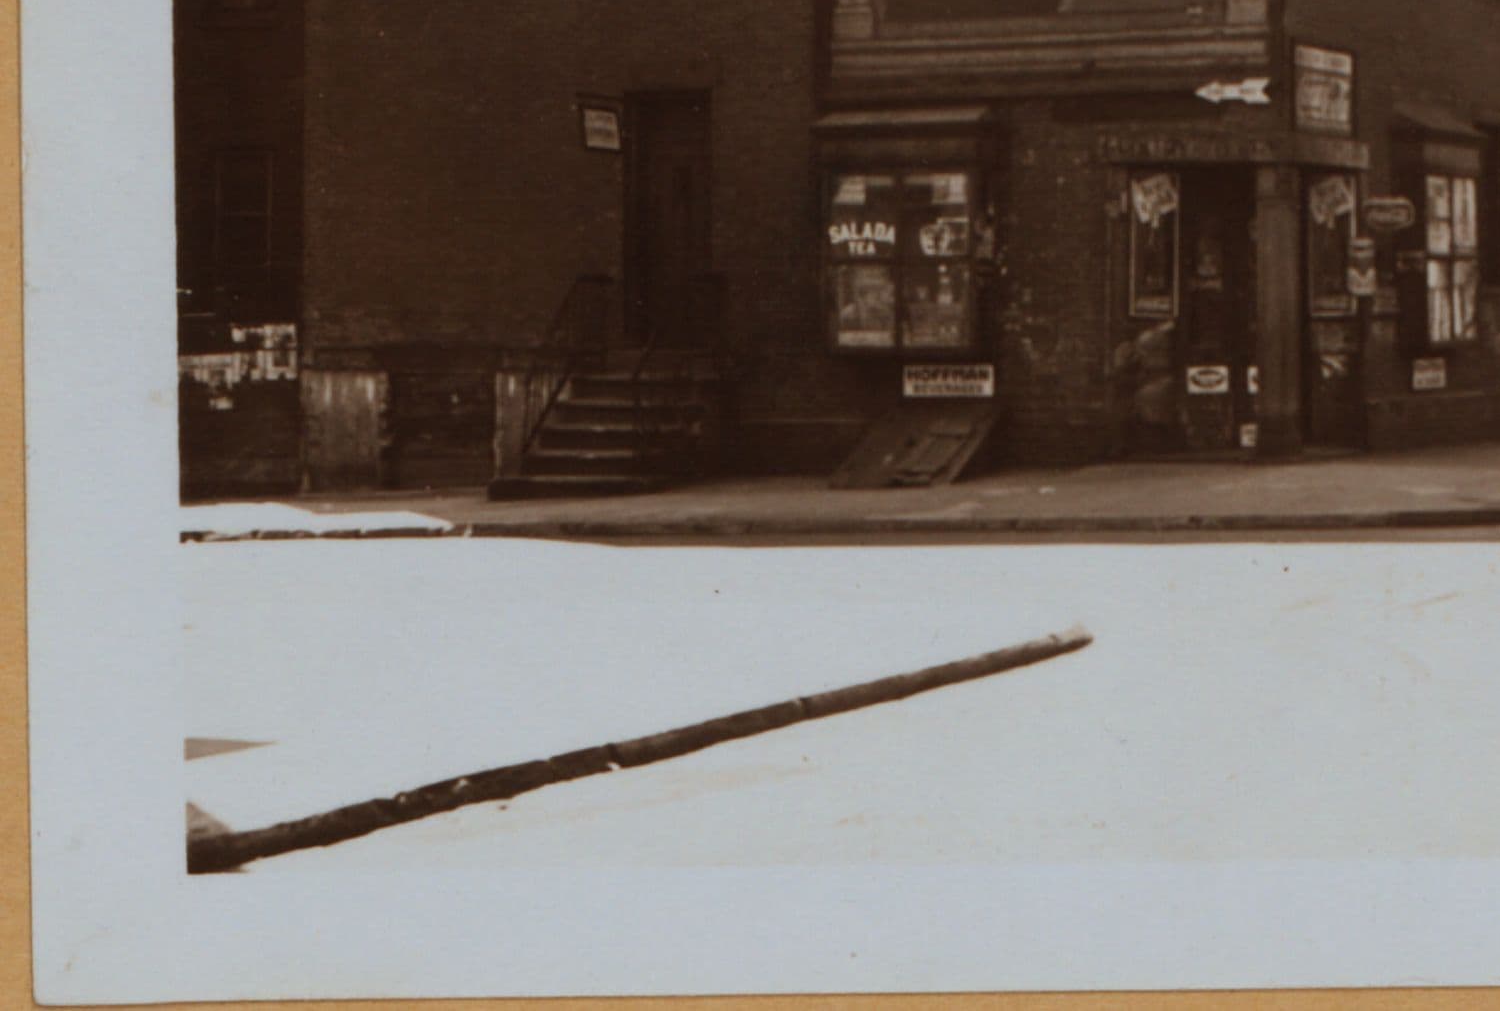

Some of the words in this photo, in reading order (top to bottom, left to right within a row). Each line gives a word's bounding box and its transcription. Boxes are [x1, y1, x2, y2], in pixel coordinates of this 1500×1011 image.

[828, 221, 896, 245] SALADA
[848, 242, 876, 256] TEA
[906, 368, 990, 381] HOFFMAN
